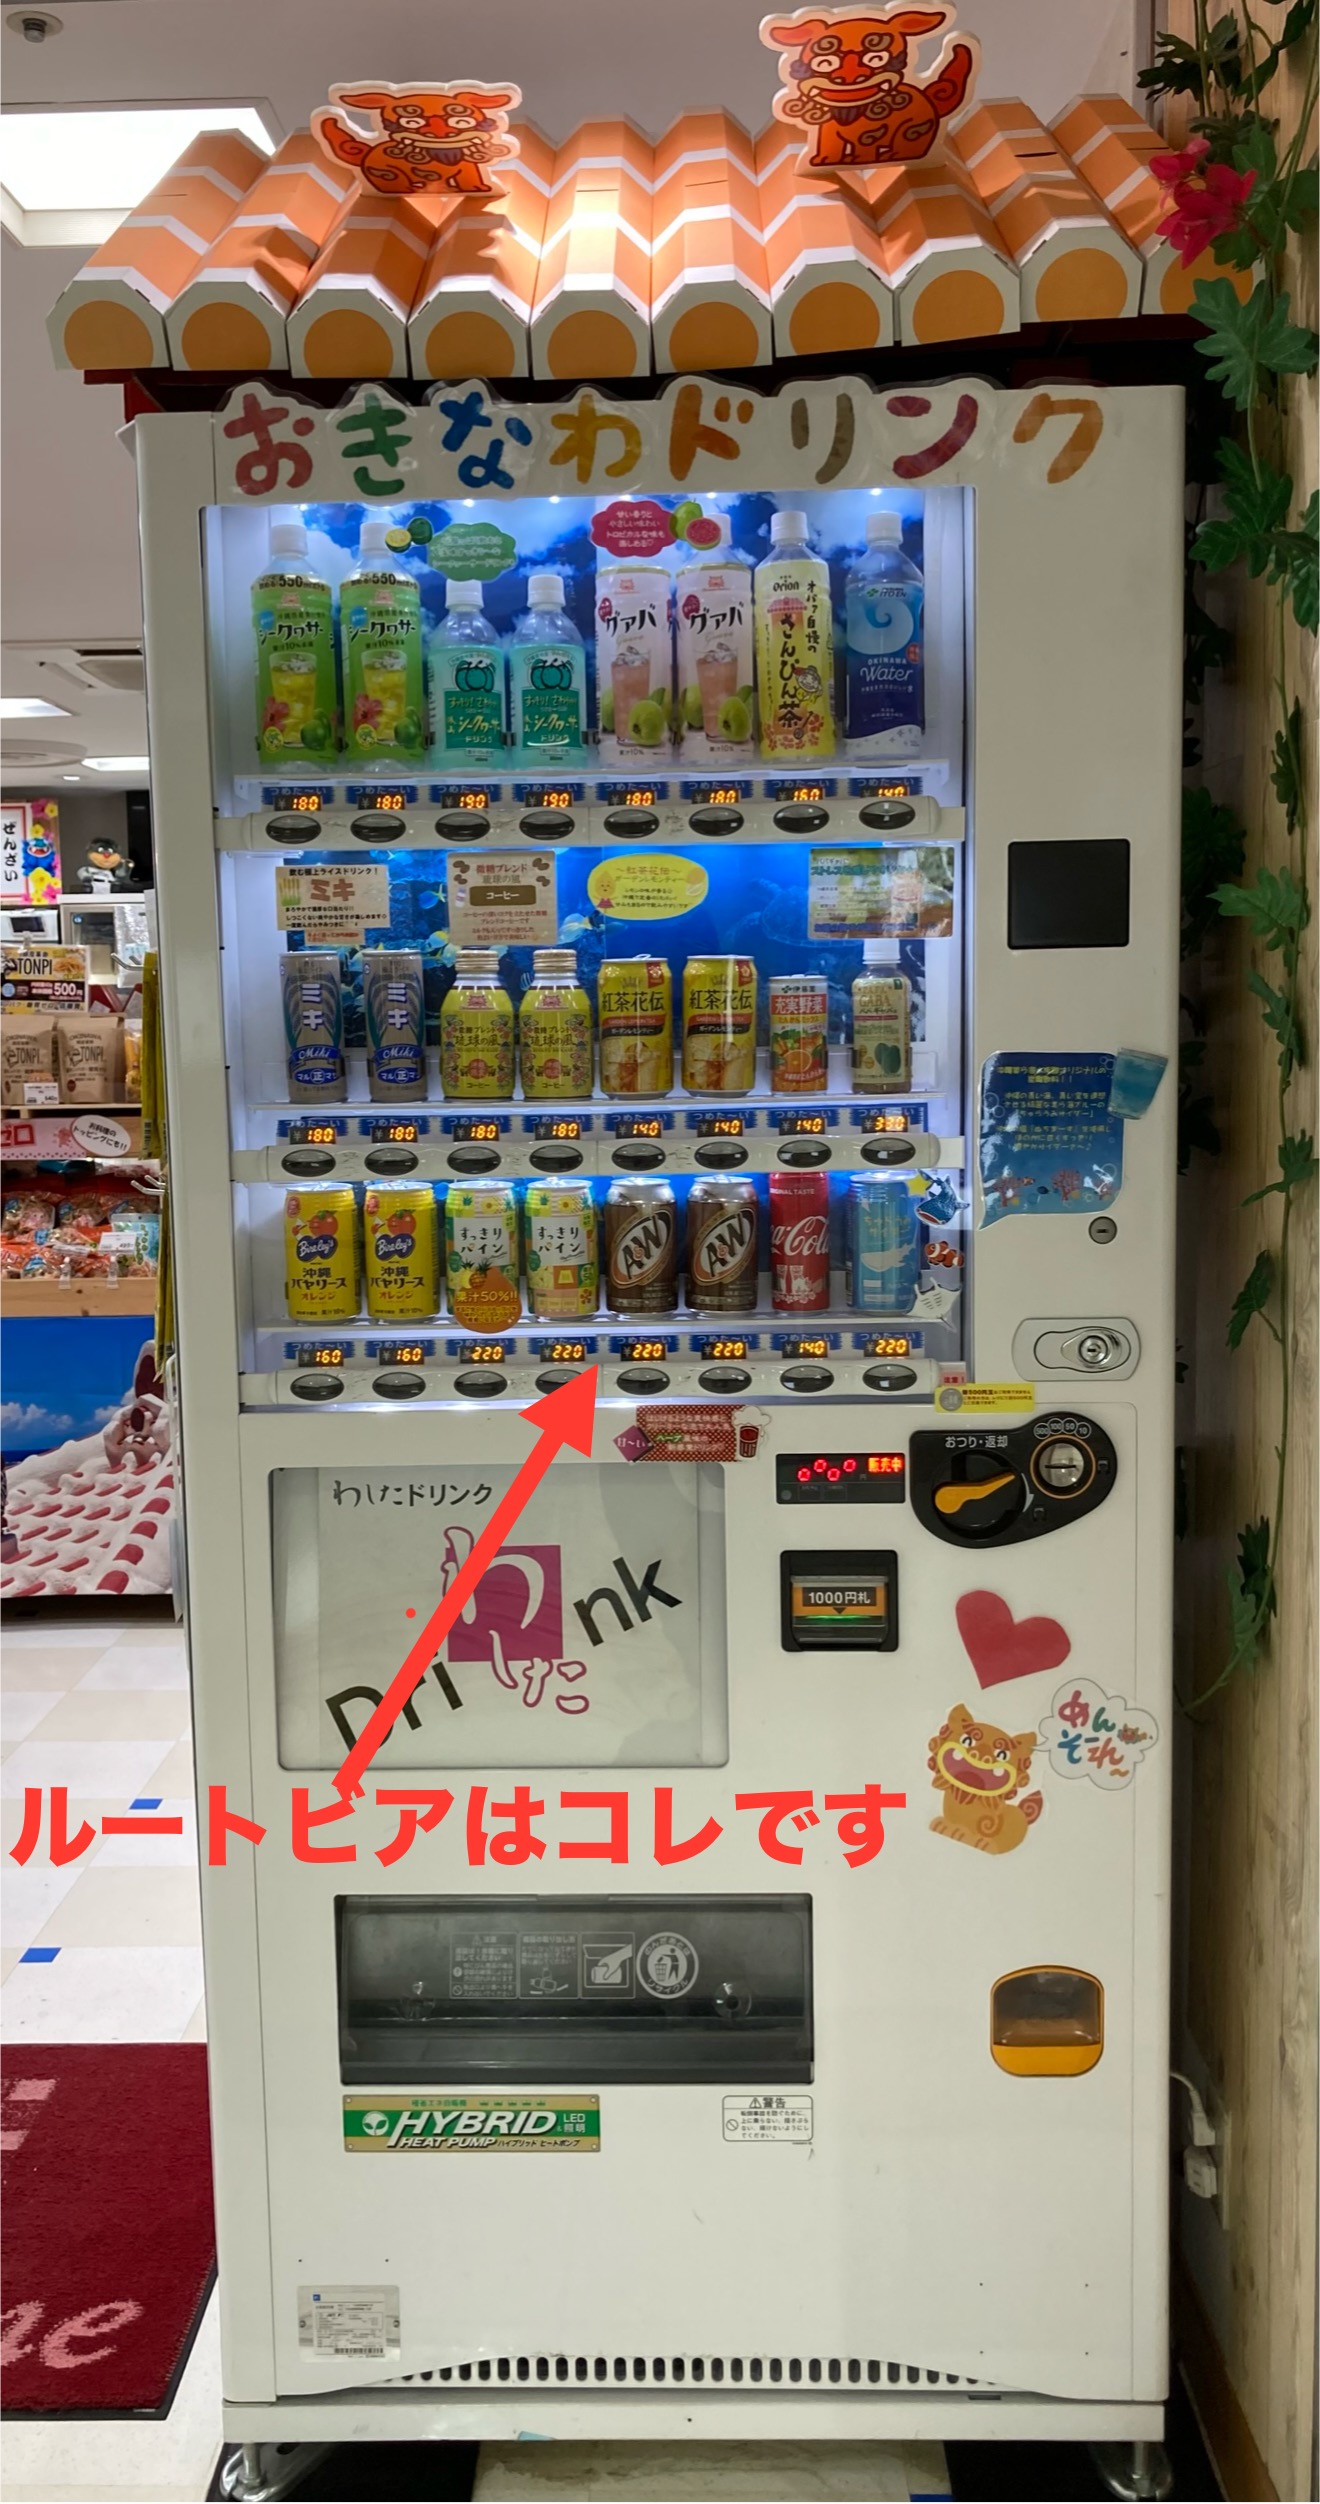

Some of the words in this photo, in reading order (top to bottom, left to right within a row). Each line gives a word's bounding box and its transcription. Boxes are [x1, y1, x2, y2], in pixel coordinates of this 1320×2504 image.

[223, 384, 1103, 496] おきなわドリンク
[868, 657, 907, 665] OKINAWA
[778, 614, 803, 728] さんぴん茶
[860, 665, 913, 682] Water
[2, 821, 18, 881] ぜんざい
[310, 879, 355, 902] ミキ
[486, 891, 520, 900] コーヒー
[17, 958, 53, 975] TONPI
[388, 982, 409, 1030] ミキ
[602, 992, 665, 1012] 紅茶花伝
[690, 989, 753, 1010] 紅茶花伝
[775, 998, 823, 1014] 充実野菜
[302, 983, 324, 1030] ミキ
[298, 1048, 331, 1059] Miki
[382, 1048, 414, 1058] Miki
[89, 1122, 116, 1137] お料理の
[460, 1227, 502, 1240] すっきり
[538, 1226, 579, 1239] すっきり
[460, 1242, 503, 1255] パイン
[538, 1241, 580, 1254] パイン
[622, 1215, 662, 1280] A&W
[706, 1213, 746, 1277] A&W
[291, 1277, 348, 1290] バヤリース
[370, 1276, 425, 1289] バヤリース
[301, 1291, 336, 1300] オレンジ
[379, 1290, 413, 1299] オレンジ
[1036, 1427, 1049, 1435] 500
[1065, 1422, 1075, 1430] 50
[1079, 1426, 1088, 1434] 10
[945, 1436, 1008, 1449] おつり・返却
[868, 1457, 902, 1472] 販売中
[333, 1480, 493, 1507] わしたドリンク
[808, 1592, 871, 1605] 1000円札
[763, 2097, 786, 2108] 警告
[563, 2113, 585, 2123] LED
[387, 2111, 557, 2148] HYBRID
[564, 2123, 586, 2133] 照明
[400, 2137, 443, 2149] HEAT
[447, 2137, 498, 2148] PUMP
